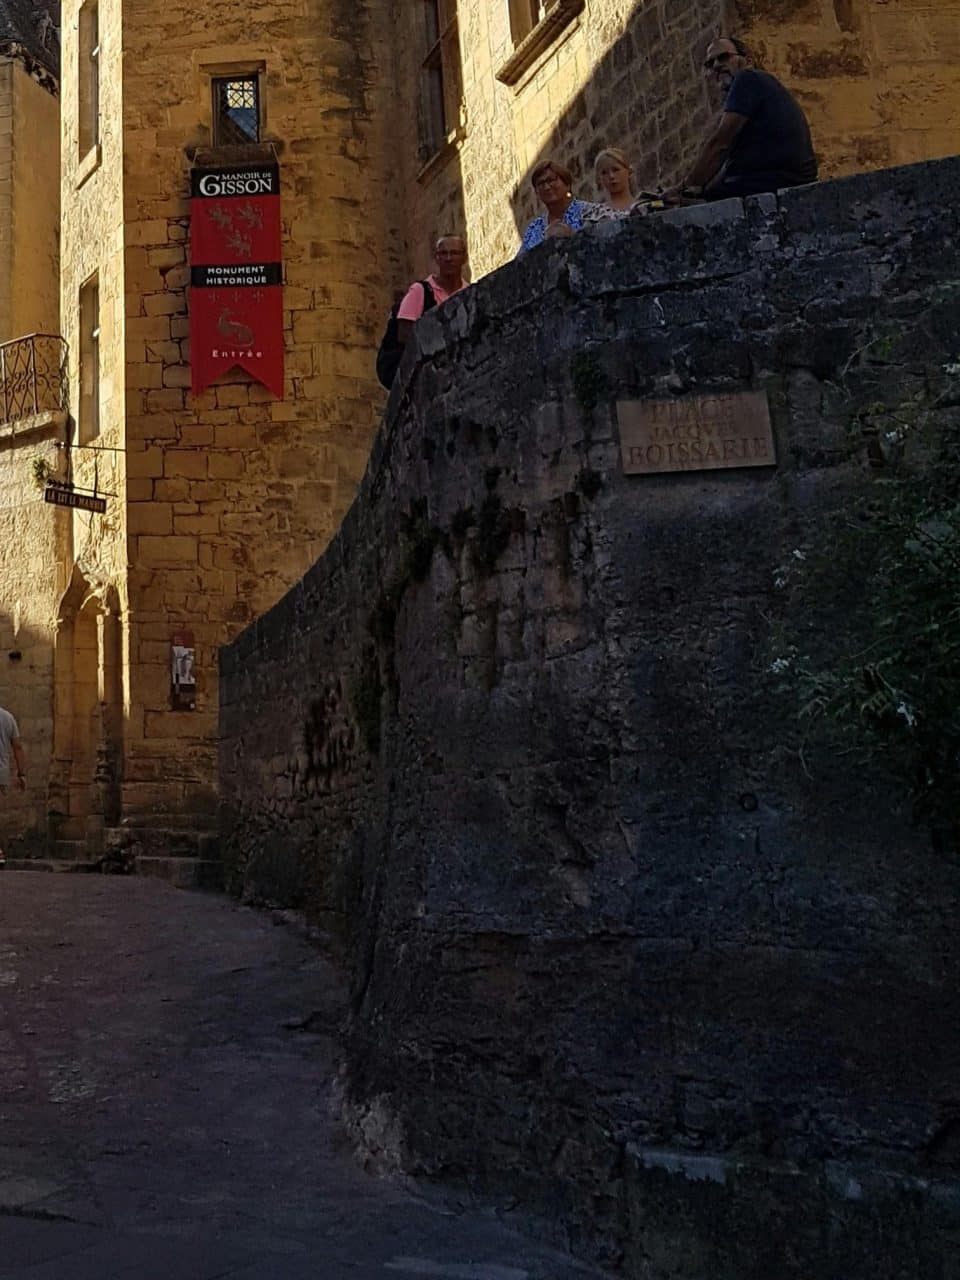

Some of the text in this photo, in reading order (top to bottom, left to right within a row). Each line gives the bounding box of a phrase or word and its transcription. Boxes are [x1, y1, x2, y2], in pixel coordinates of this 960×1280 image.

[222, 172, 260, 180] MANOIR
[199, 174, 272, 196] GISSON
[207, 265, 265, 275] MONUMENT
[206, 275, 267, 286] HISTORIQUE
[212, 349, 262, 358] Entrée
[648, 398, 735, 424] PLACE
[628, 438, 768, 465] BOISSARIE
